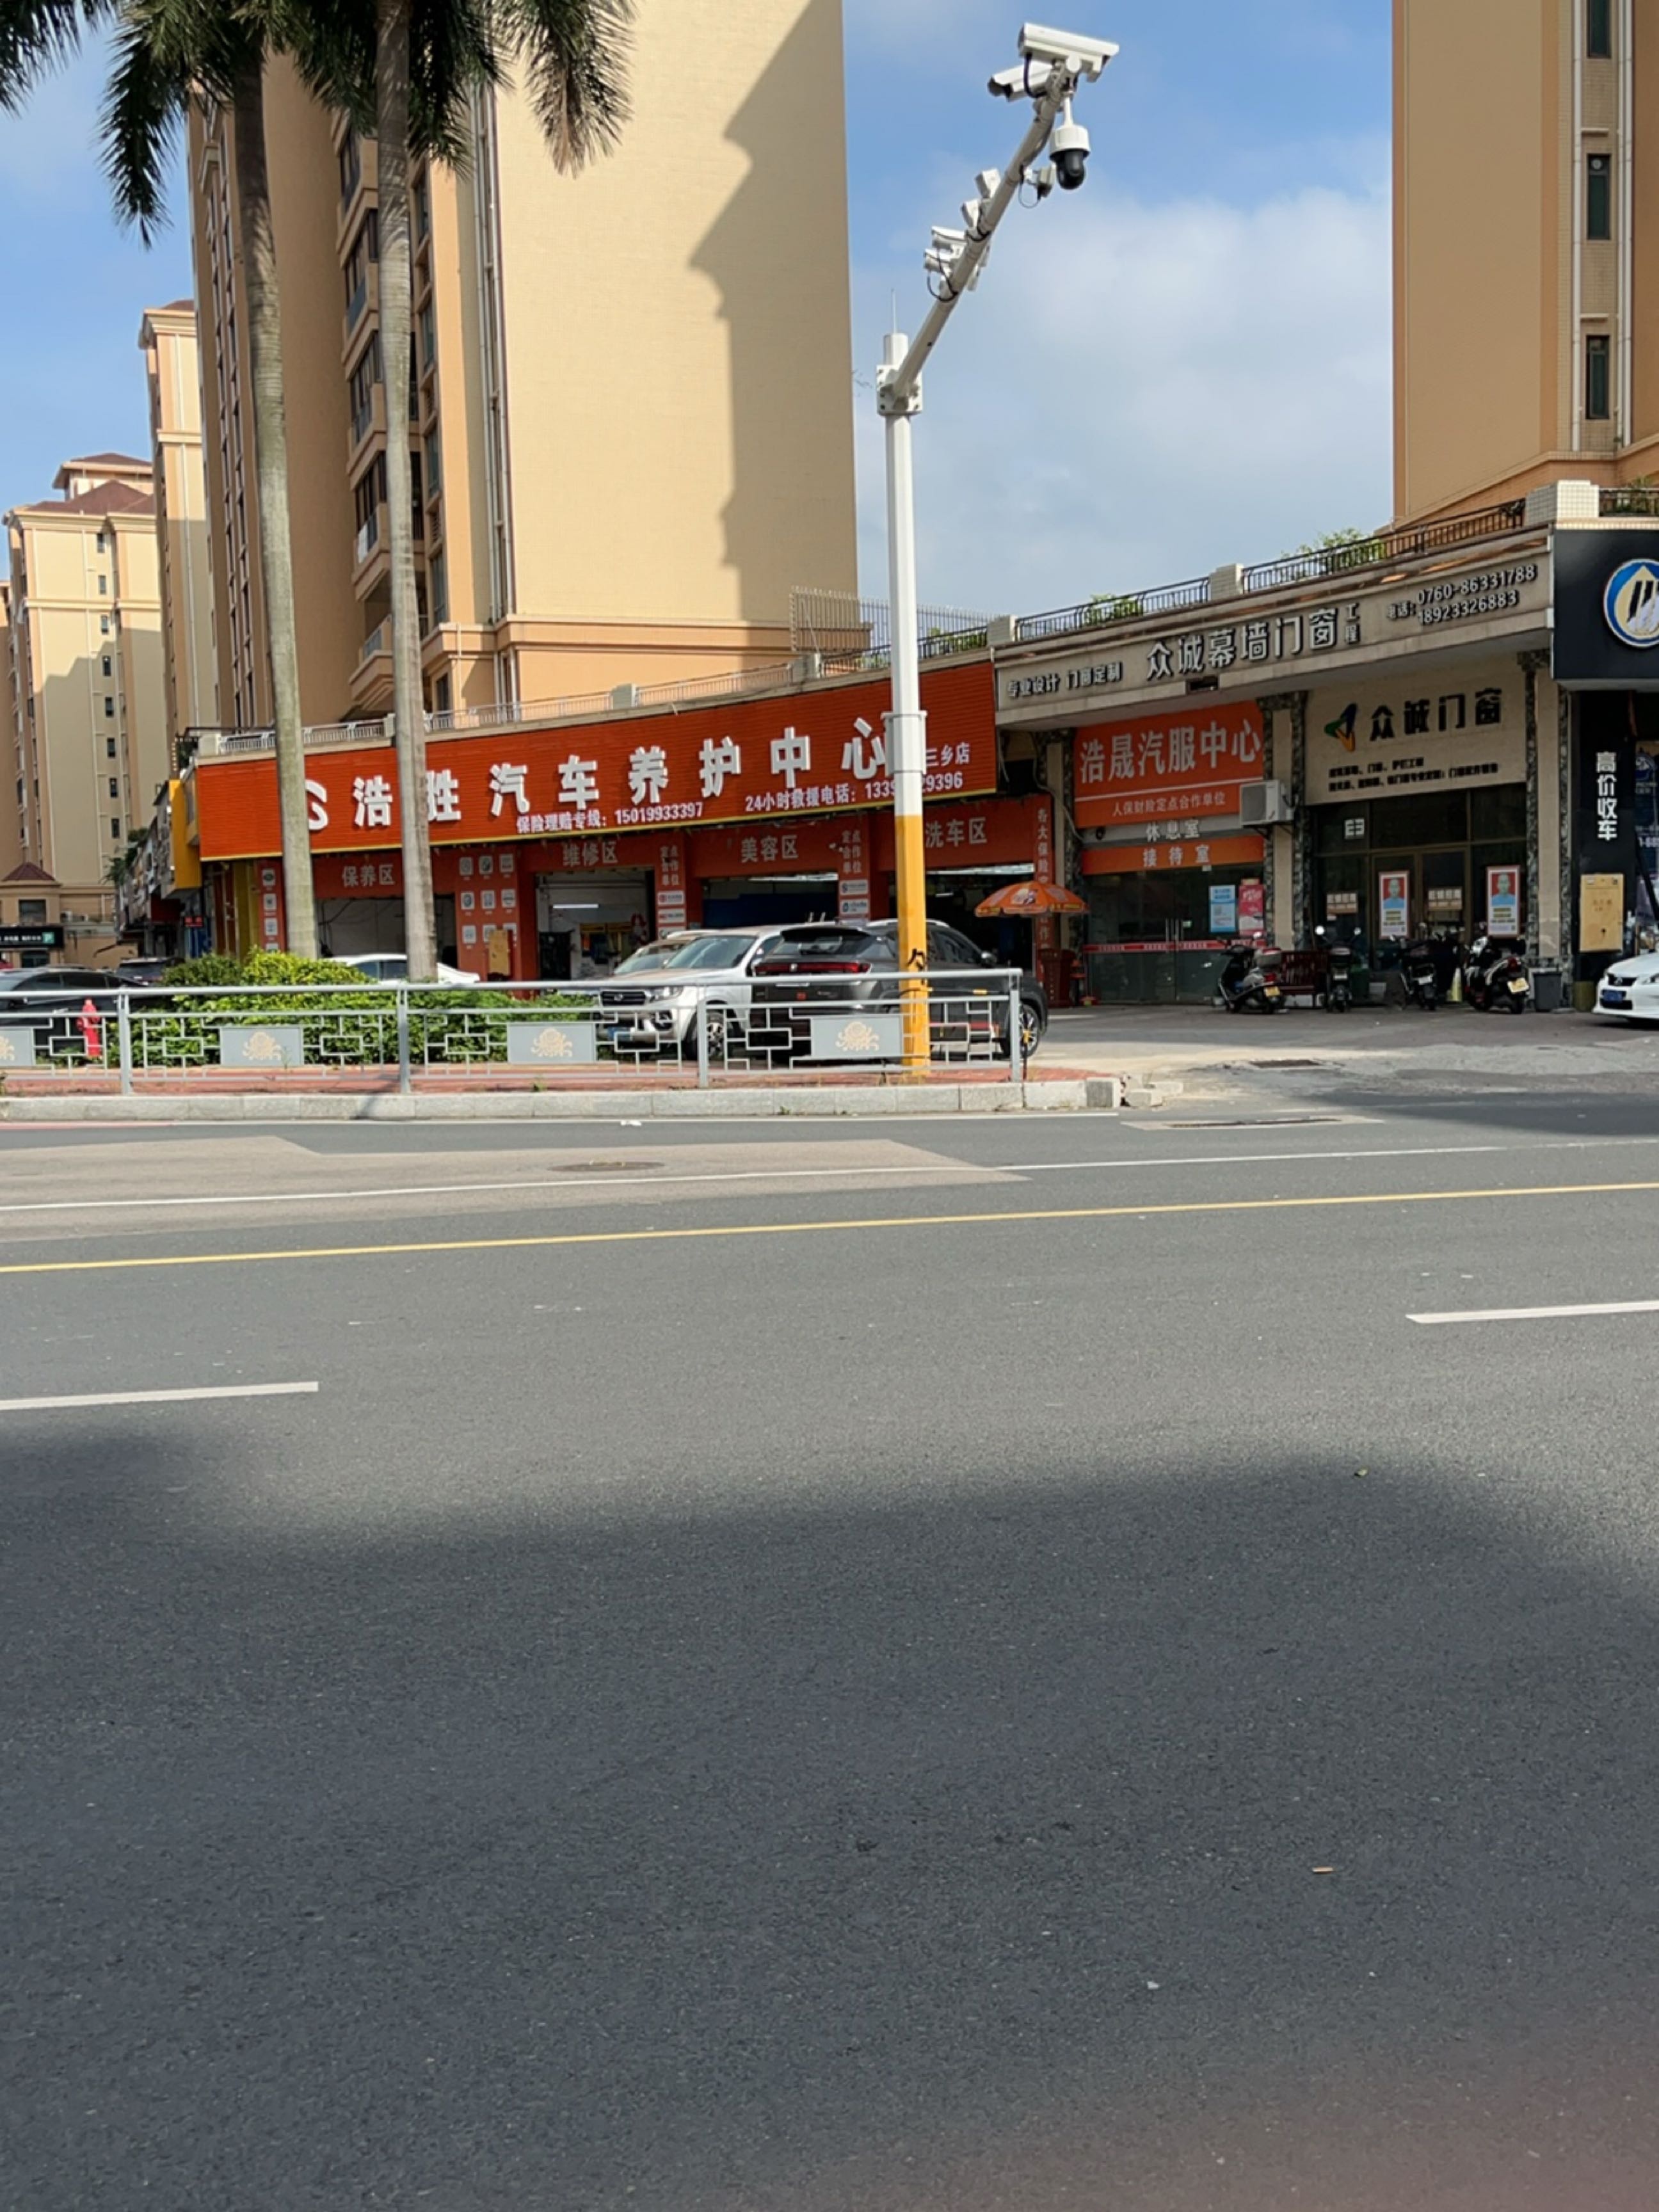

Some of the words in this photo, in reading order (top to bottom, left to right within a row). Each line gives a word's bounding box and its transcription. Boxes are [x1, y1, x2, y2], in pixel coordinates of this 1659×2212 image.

[1416, 563, 1537, 604] 0760-86331788
[1418, 589, 1519, 626] 18923326883
[1147, 607, 1338, 681] 众诚幕墙门窗
[924, 742, 970, 767] 三乡店
[1079, 718, 1261, 784] 浩晟汽服中心
[1596, 751, 1618, 842] 高价收车
[614, 801, 703, 825] 15019933397
[925, 817, 988, 848] 洗车区
[1146, 819, 1200, 842] 休息室
[562, 840, 618, 868] 维修区
[741, 835, 799, 864] 美容区
[1142, 844, 1210, 868] 接待室
[341, 863, 396, 888] 保养区
